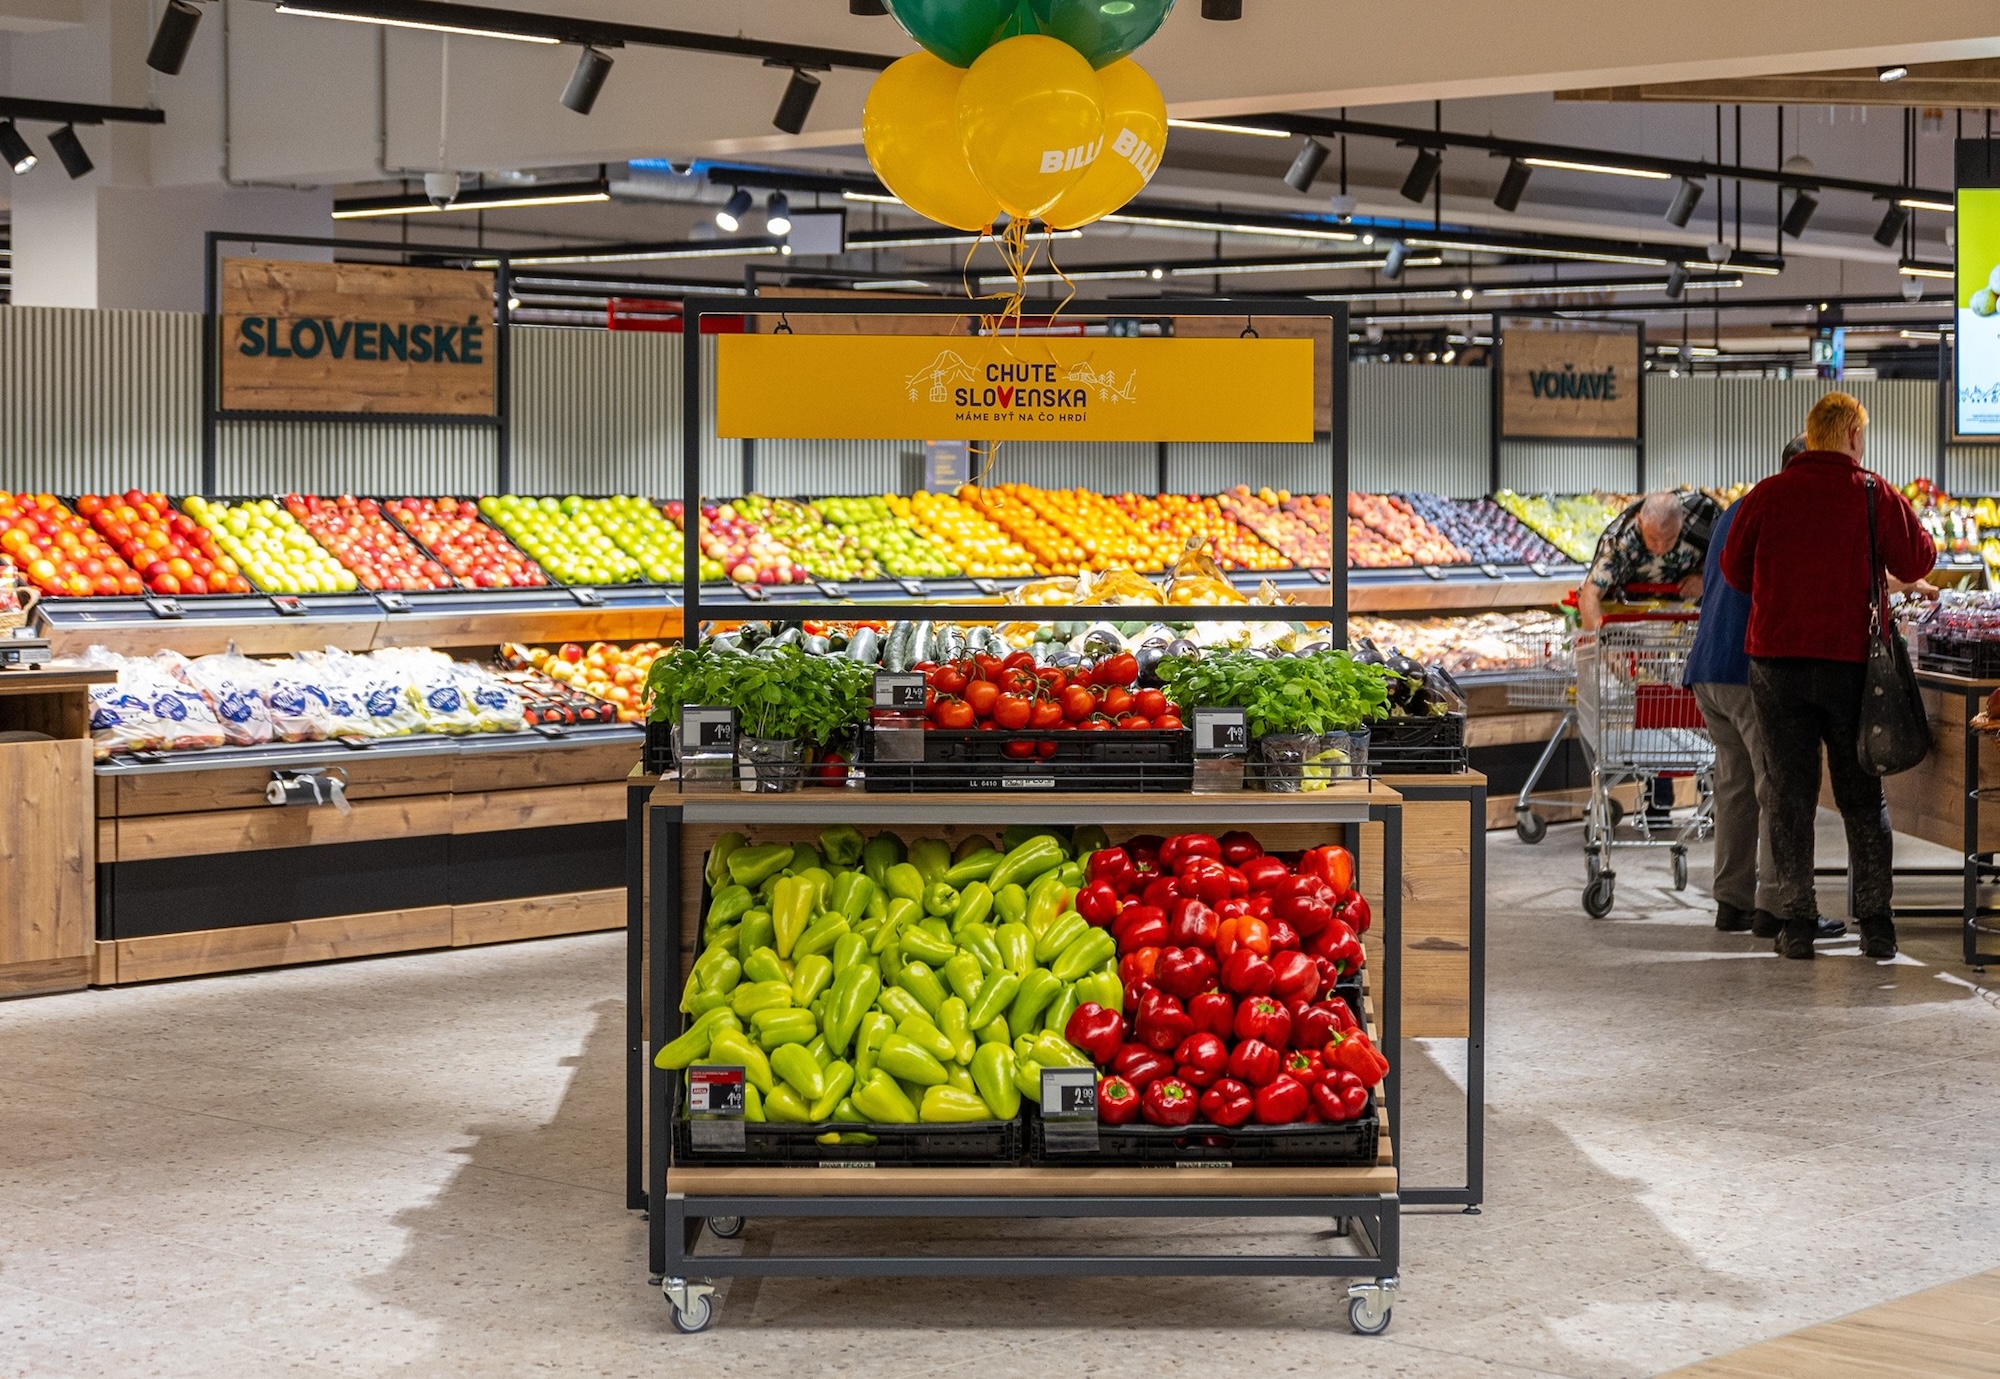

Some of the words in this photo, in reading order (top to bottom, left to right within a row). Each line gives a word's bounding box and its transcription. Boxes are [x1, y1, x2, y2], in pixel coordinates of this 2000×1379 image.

[1112, 127, 1159, 183] BILL
[239, 315, 483, 364] SLOVENSKÉ
[986, 363, 1057, 383] CHUTE
[1528, 363, 1617, 401] VOŇAVÉ
[955, 385, 1087, 409] SLOVENSKA
[955, 411, 990, 421] MÁME
[994, 411, 1014, 421] BYŤ
[1018, 412, 1034, 422] NA
[1038, 410, 1055, 422] ČO
[1059, 411, 1087, 422] HRDÍ
